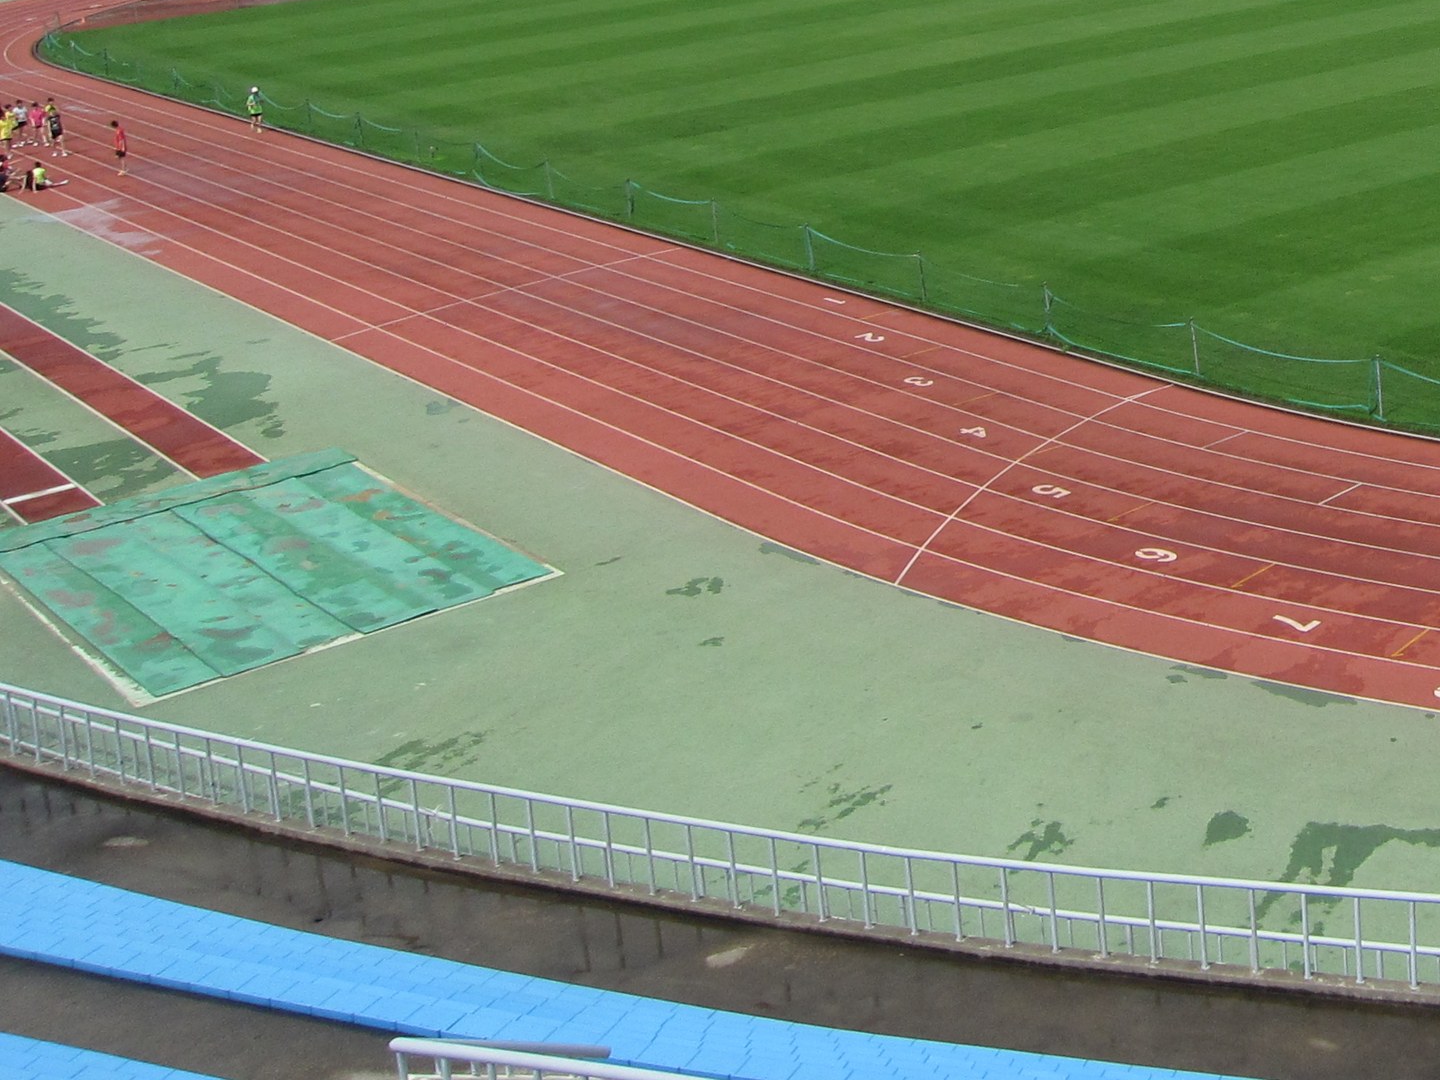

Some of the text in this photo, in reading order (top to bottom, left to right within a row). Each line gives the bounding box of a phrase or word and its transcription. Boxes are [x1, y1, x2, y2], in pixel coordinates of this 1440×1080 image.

[854, 331, 885, 344] 2
[903, 376, 934, 387] 3
[959, 426, 988, 438] 4
[1031, 484, 1072, 500] 5
[1134, 547, 1178, 563] 6
[1272, 614, 1322, 633] 7
